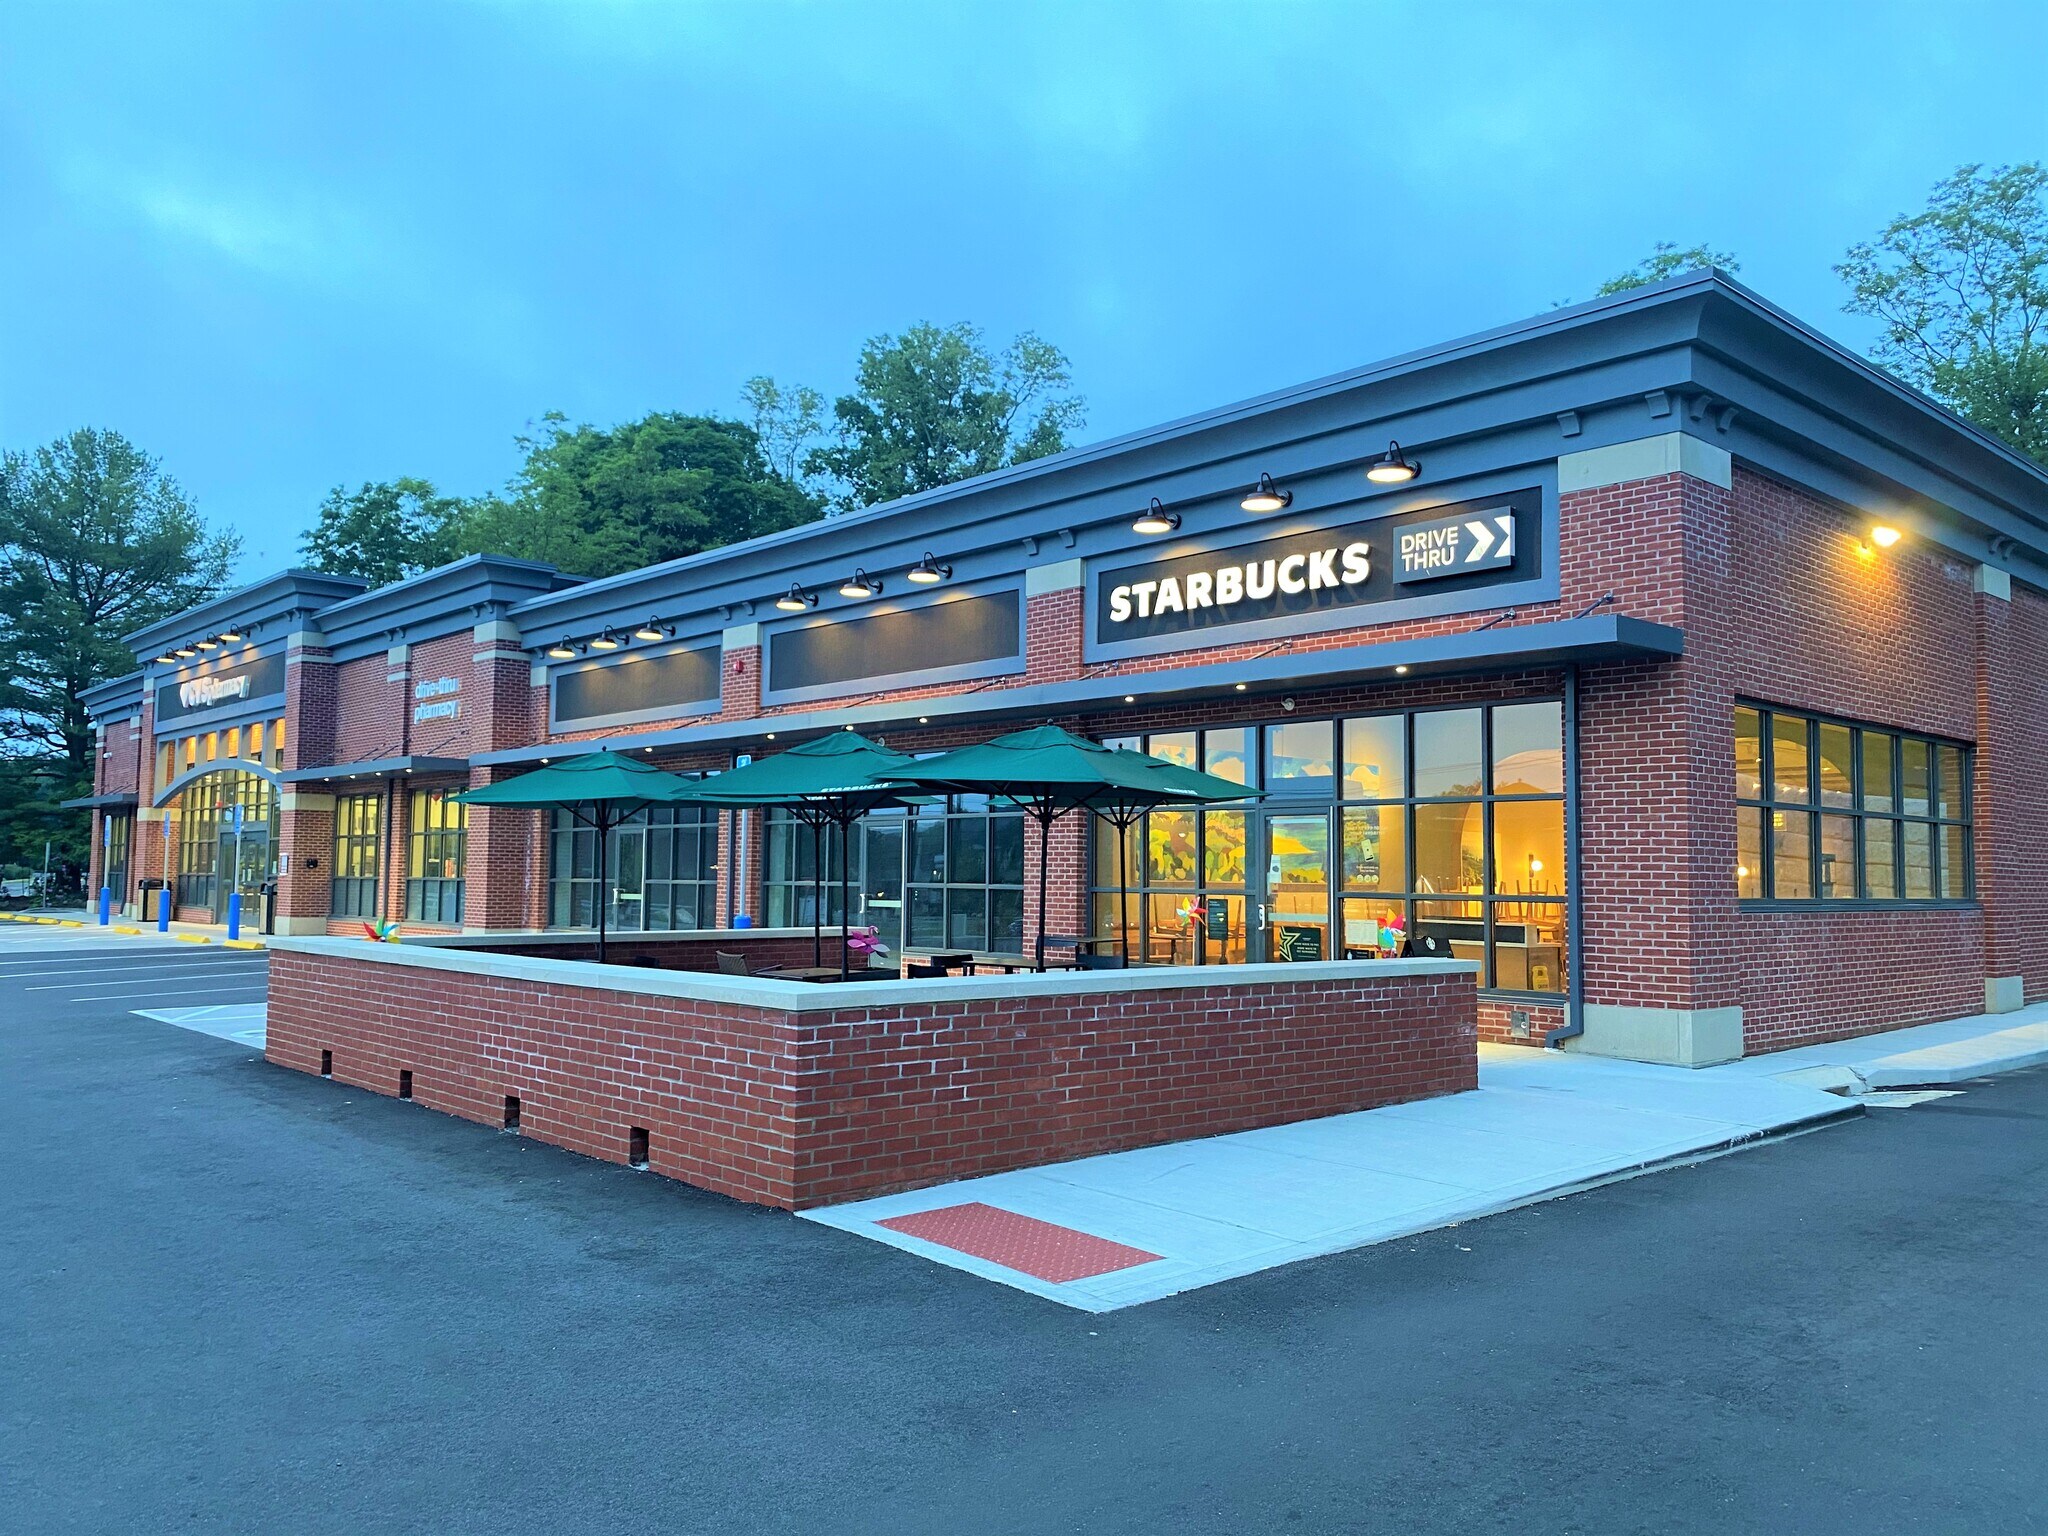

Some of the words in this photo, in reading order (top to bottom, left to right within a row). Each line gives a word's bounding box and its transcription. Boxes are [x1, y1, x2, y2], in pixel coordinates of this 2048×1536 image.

[1401, 526, 1459, 554] DRIVE
[1401, 546, 1455, 572] THRU
[1109, 541, 1371, 623] STARBUCKS
[413, 695, 458, 725] pharmacy
